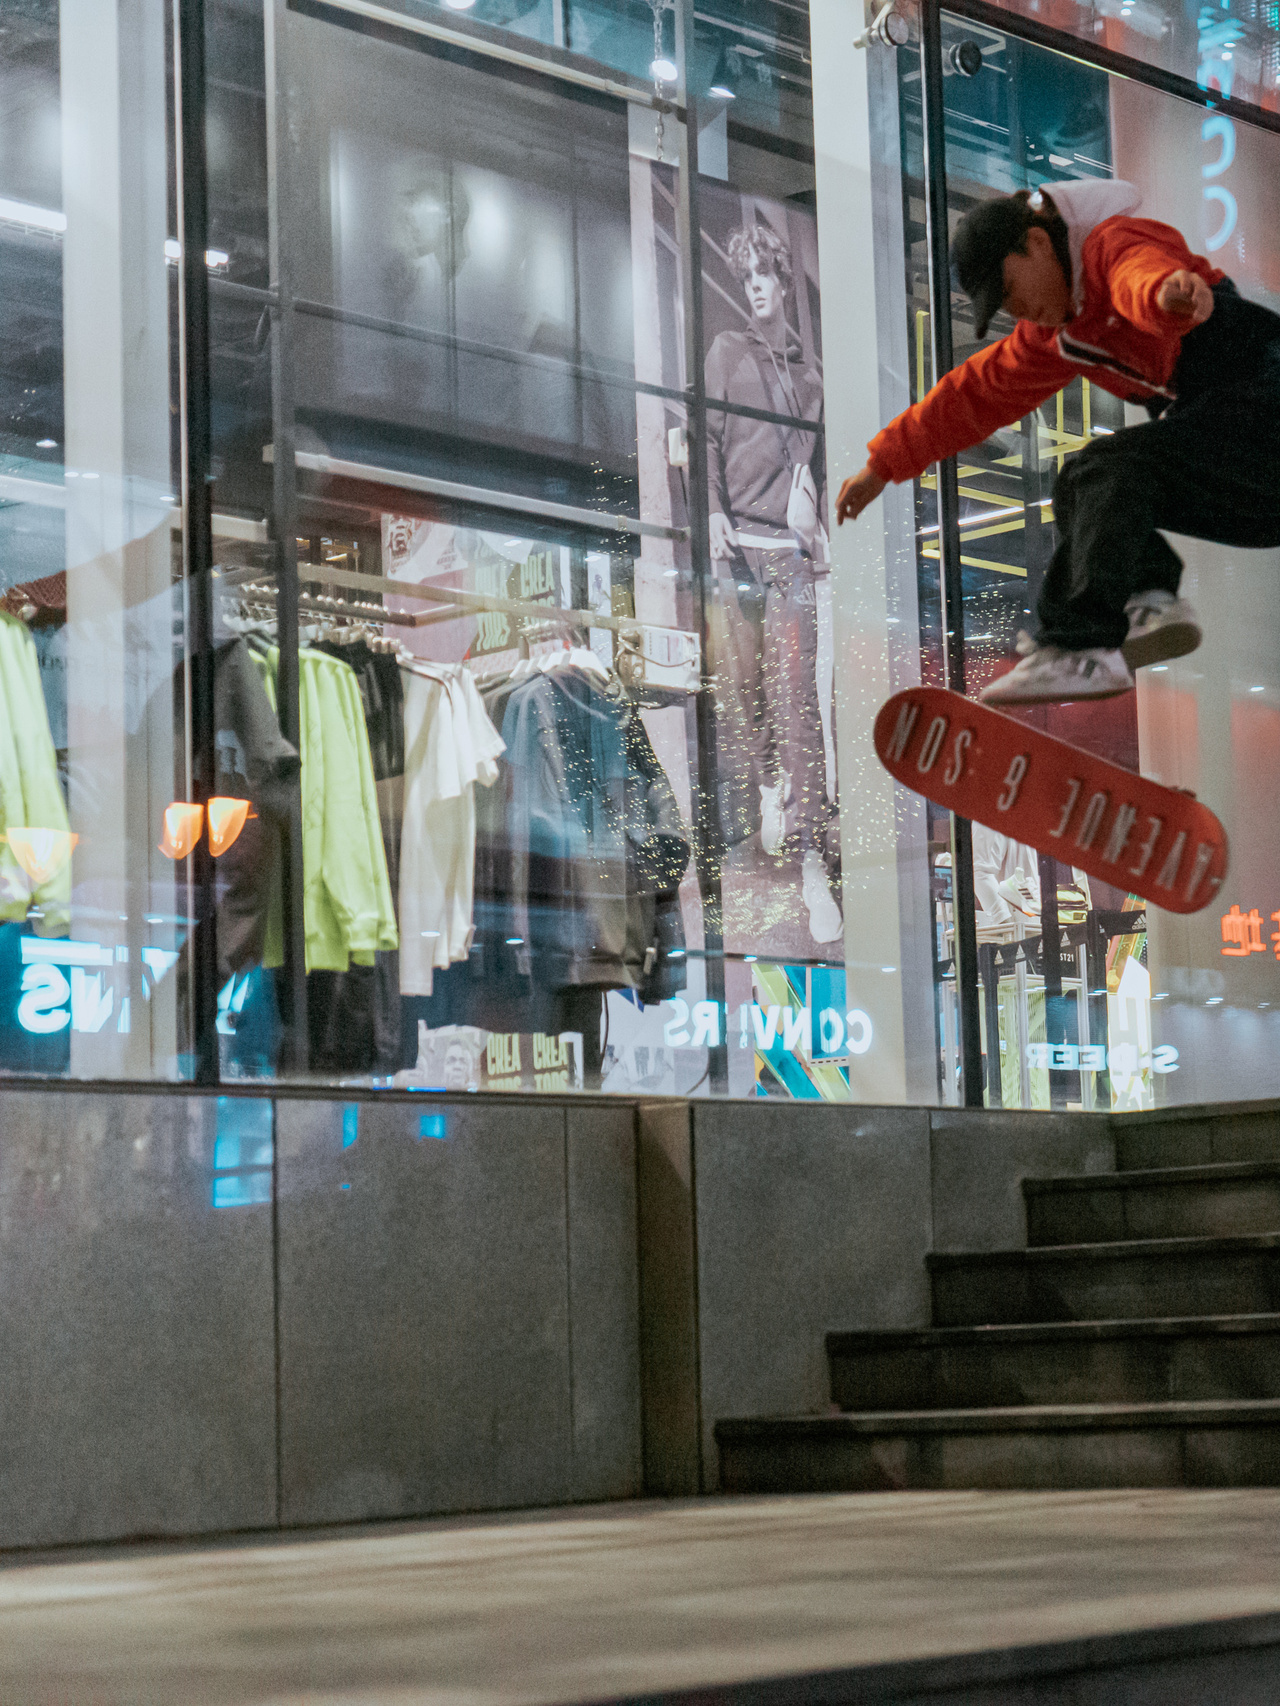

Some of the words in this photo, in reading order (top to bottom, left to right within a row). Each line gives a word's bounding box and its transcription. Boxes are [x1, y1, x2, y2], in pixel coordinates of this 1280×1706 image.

[886, 701, 973, 786] SON
[1049, 777, 1215, 901] AVENUE
[486, 1031, 522, 1076] CREA
